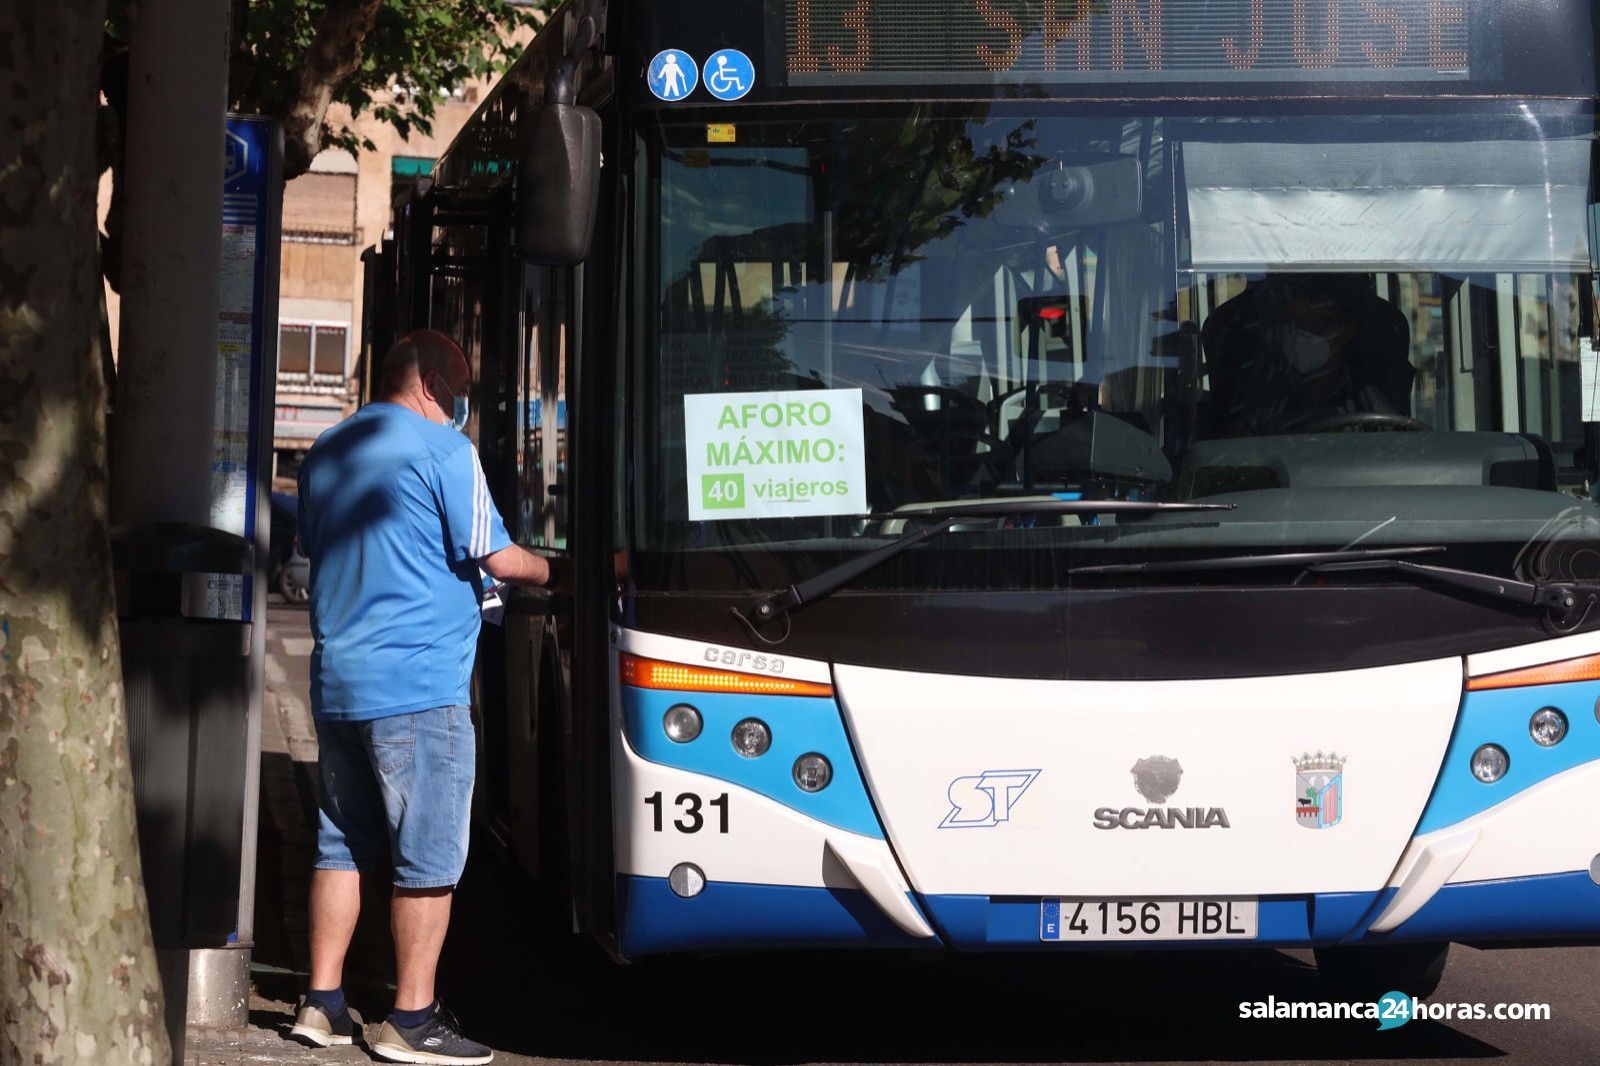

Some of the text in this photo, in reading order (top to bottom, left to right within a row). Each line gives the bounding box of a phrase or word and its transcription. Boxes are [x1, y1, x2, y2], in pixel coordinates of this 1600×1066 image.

[786, 0, 870, 72] 13
[975, 0, 1162, 71] SAN
[717, 401, 831, 430] AFORO
[706, 435, 845, 467] MÁXIMO:
[707, 477, 849, 503] 40 viajeros
[703, 646, 785, 674] carsa
[644, 790, 730, 834] 131
[1092, 806, 1231, 830] SCANIA
[1046, 901, 1247, 935] E 4156 HBL
